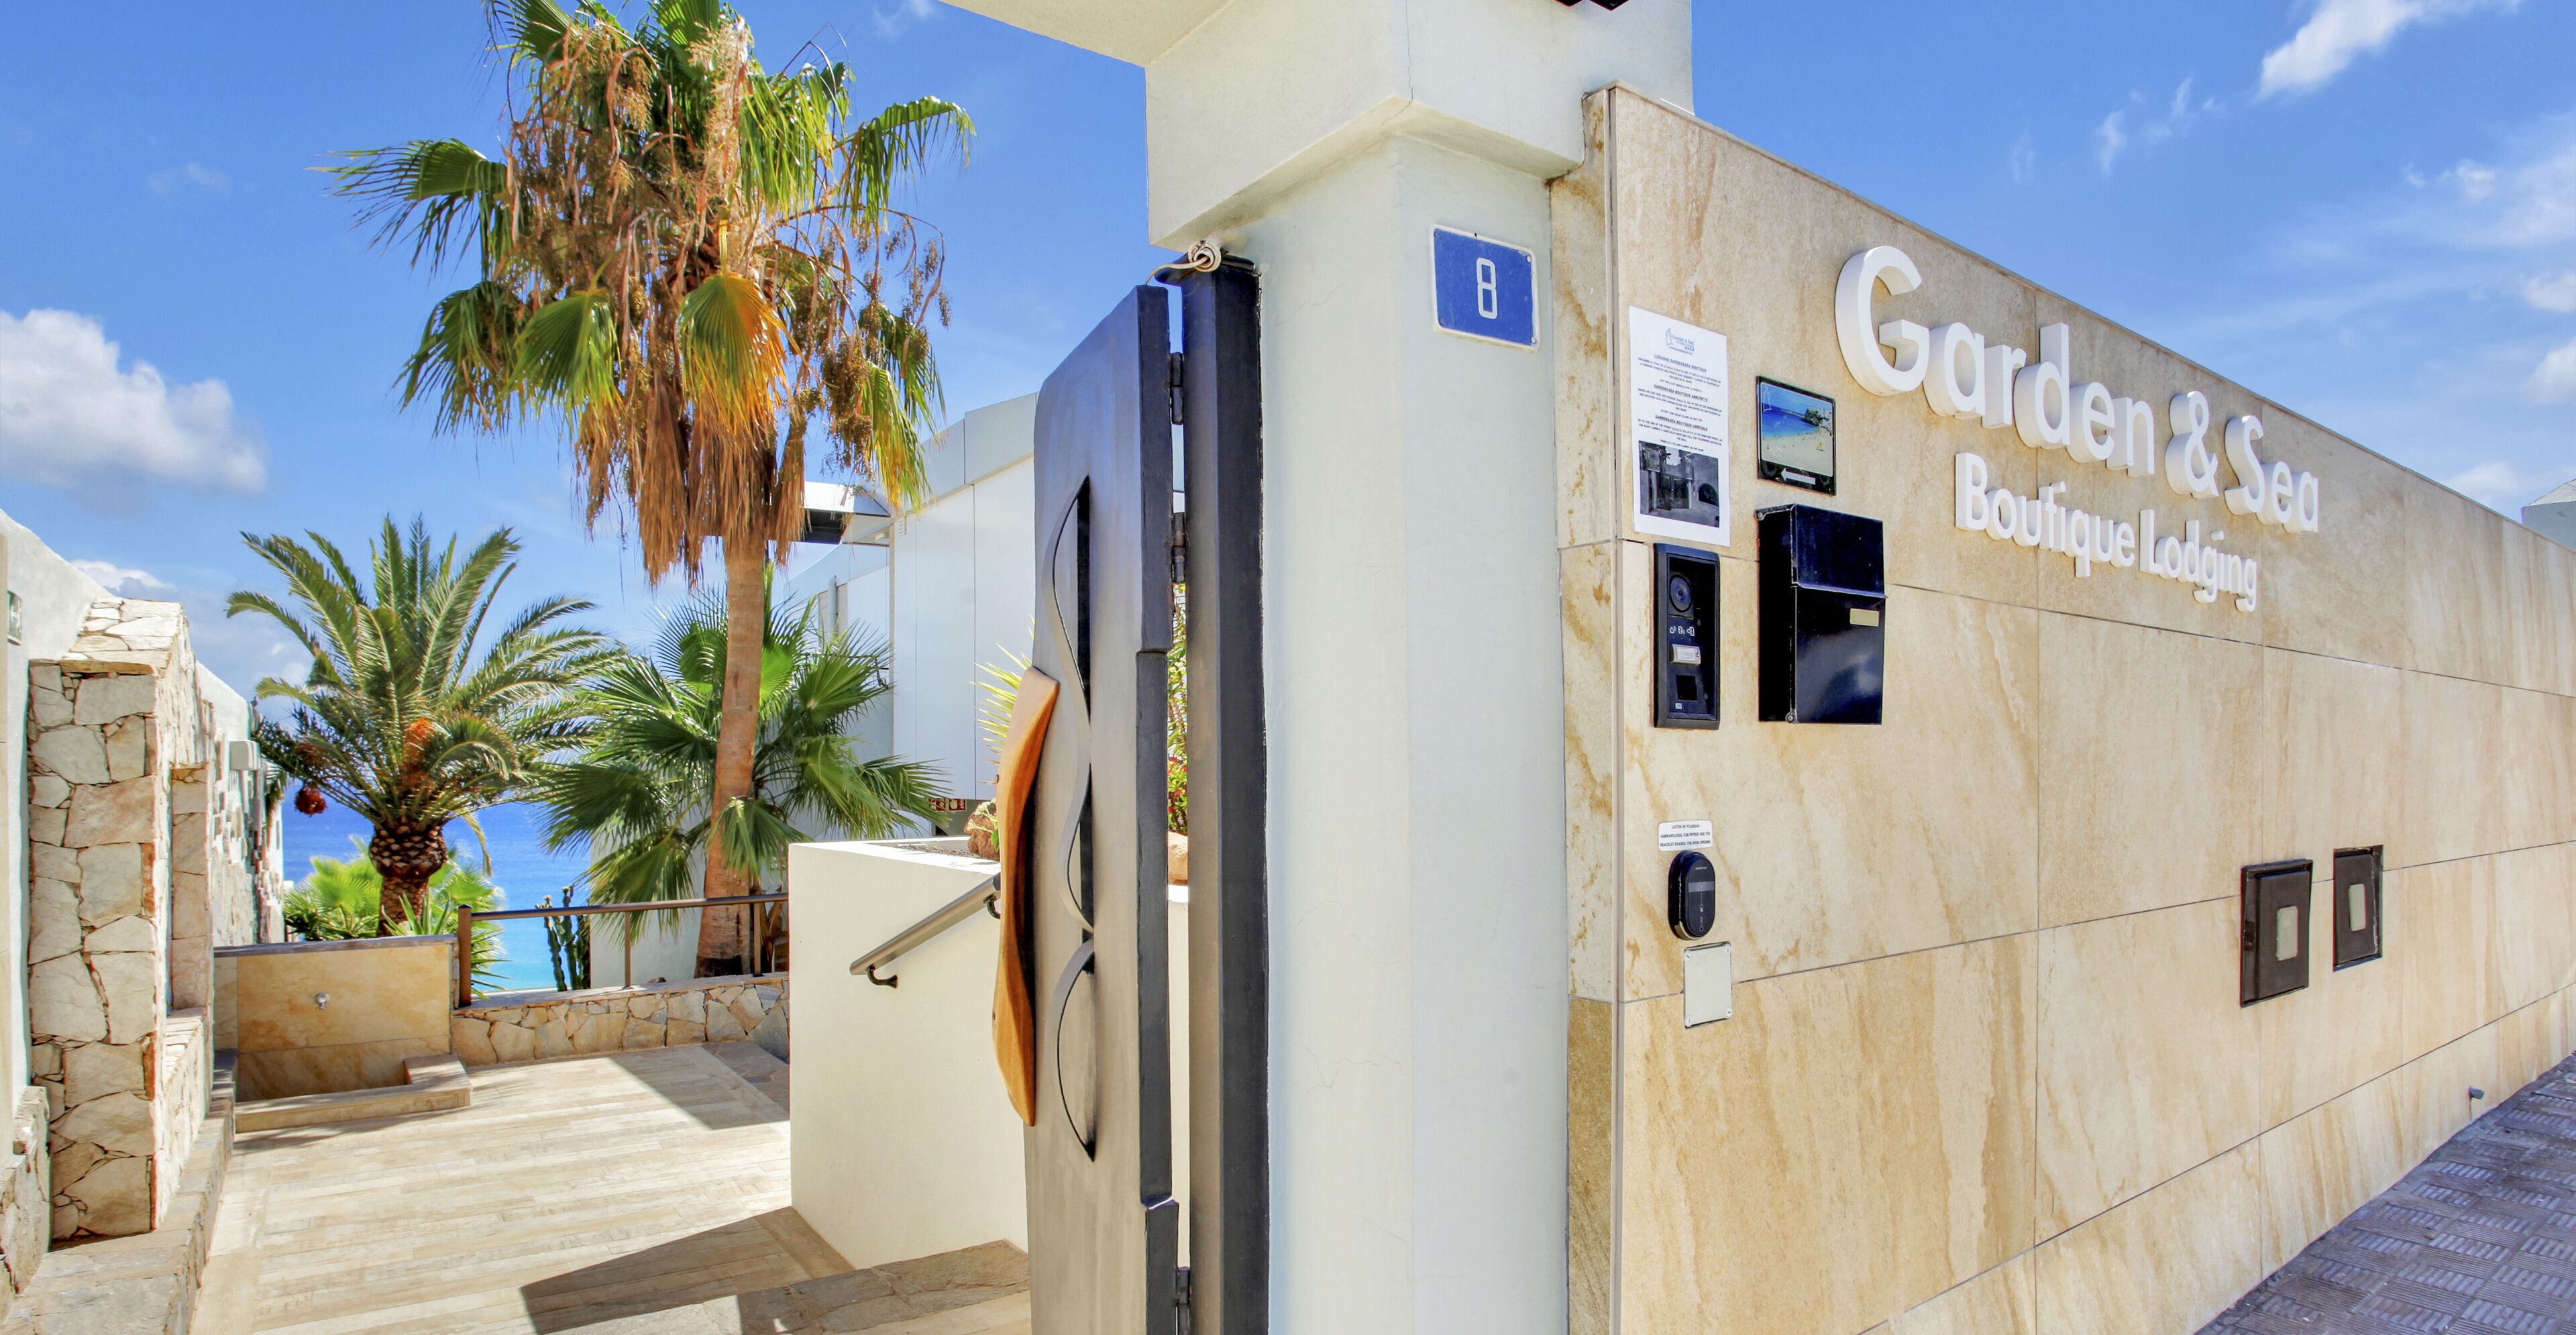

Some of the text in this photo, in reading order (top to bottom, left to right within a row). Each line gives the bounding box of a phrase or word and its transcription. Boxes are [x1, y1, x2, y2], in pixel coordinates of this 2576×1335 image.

[1476, 257, 1498, 320] 8
[1835, 246, 2319, 533] Garden & Sea
[1955, 452, 2257, 612] Boutique Lodging
